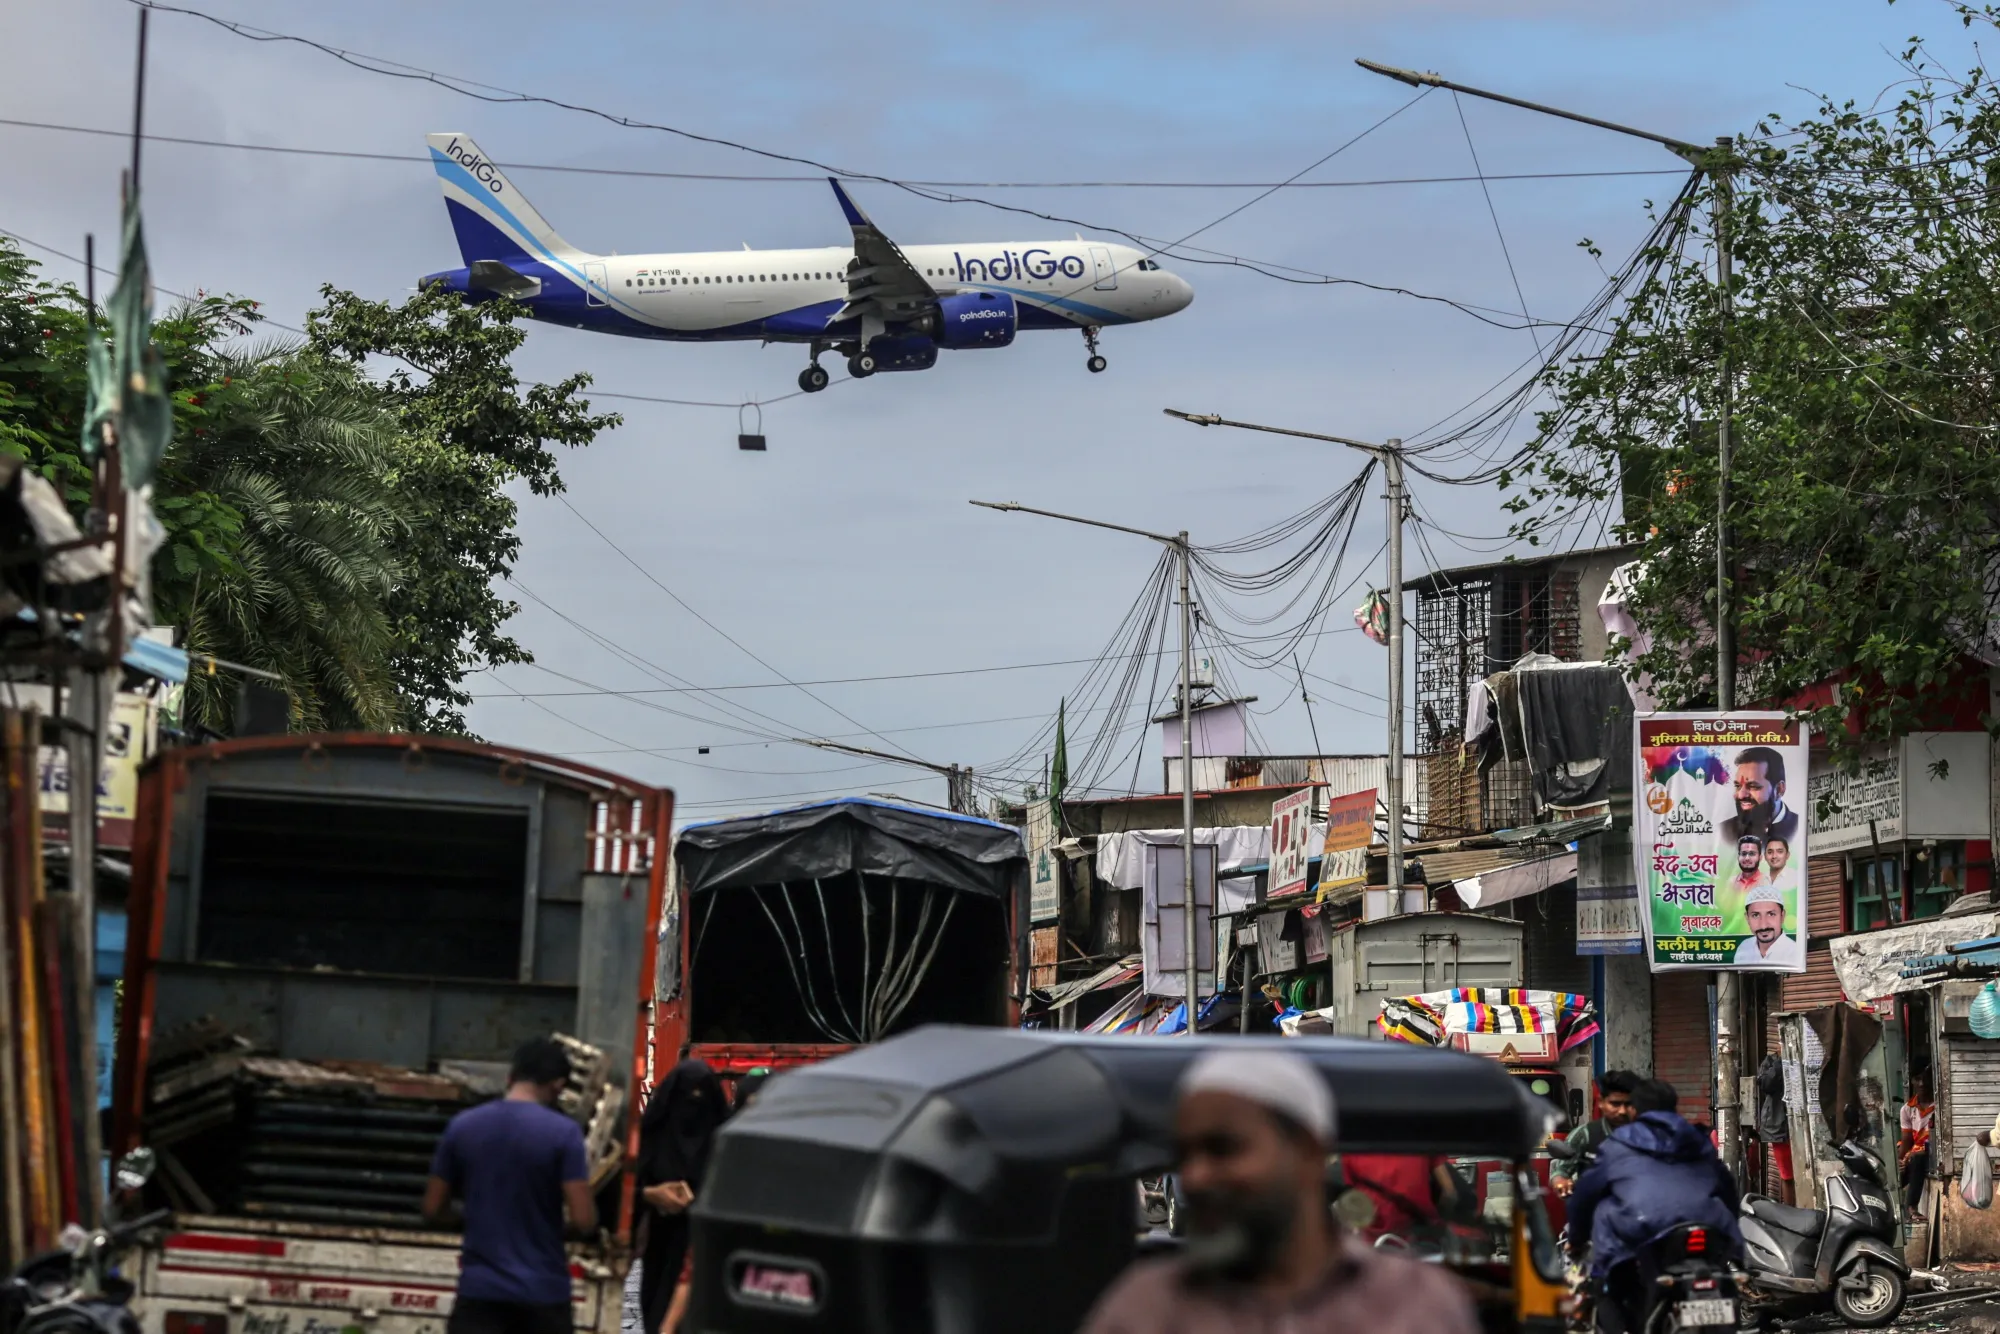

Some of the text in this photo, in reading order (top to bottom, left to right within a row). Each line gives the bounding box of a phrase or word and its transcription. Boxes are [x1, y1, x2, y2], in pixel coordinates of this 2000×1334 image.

[446, 137, 503, 193] IndiGo
[954, 249, 1085, 282] IndiGo
[960, 310, 1006, 322] goIndiGo.in
[1693, 720, 1712, 731] शिव
[1728, 720, 1747, 731] सेना
[1650, 732, 1690, 746] मुस्लिम
[1692, 732, 1715, 743] सेवा
[1717, 731, 1753, 743] समिती
[1681, 916, 1722, 932] मुबारक
[1656, 936, 1700, 951] सलीम
[1703, 939, 1736, 951] भाऊ
